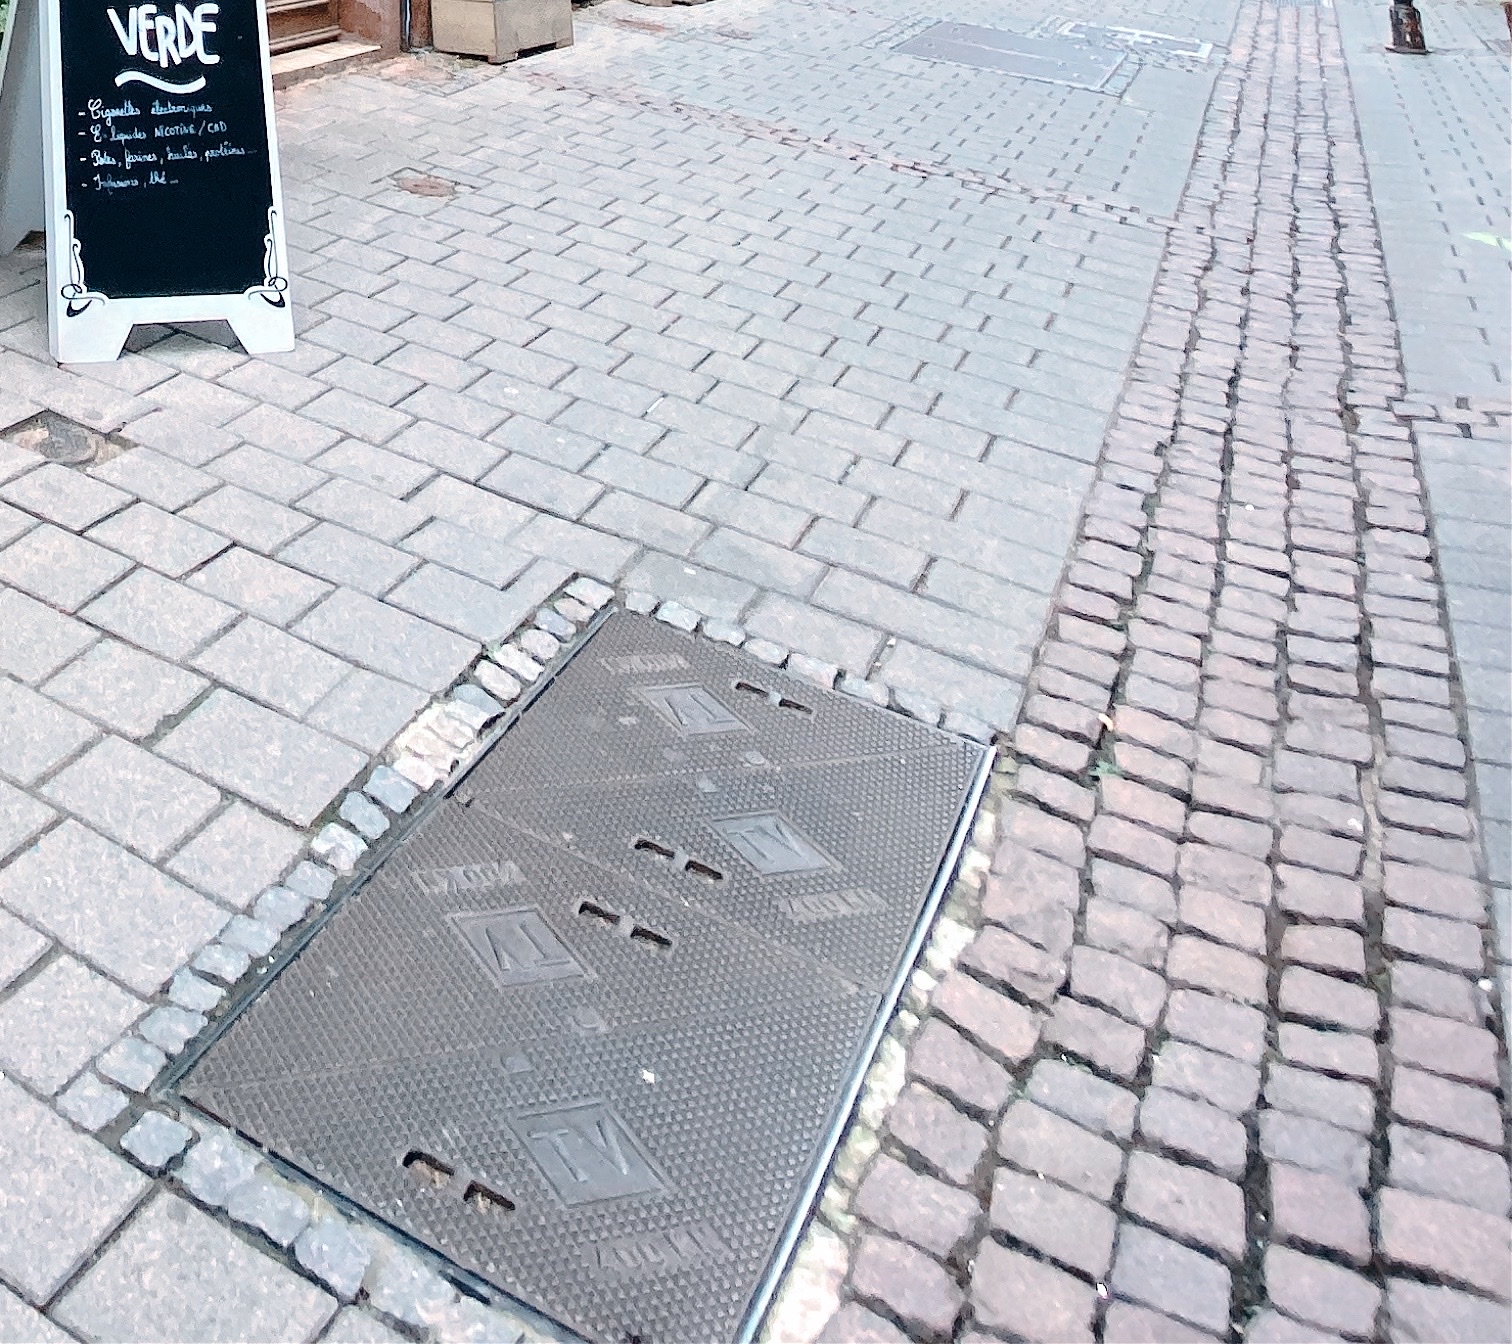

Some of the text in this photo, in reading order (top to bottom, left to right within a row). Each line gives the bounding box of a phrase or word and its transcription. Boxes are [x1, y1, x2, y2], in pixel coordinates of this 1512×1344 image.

[106, 3, 220, 68] VERDE
[725, 822, 805, 865] TV
[483, 921, 572, 972] TV
[527, 1119, 630, 1183] TV
